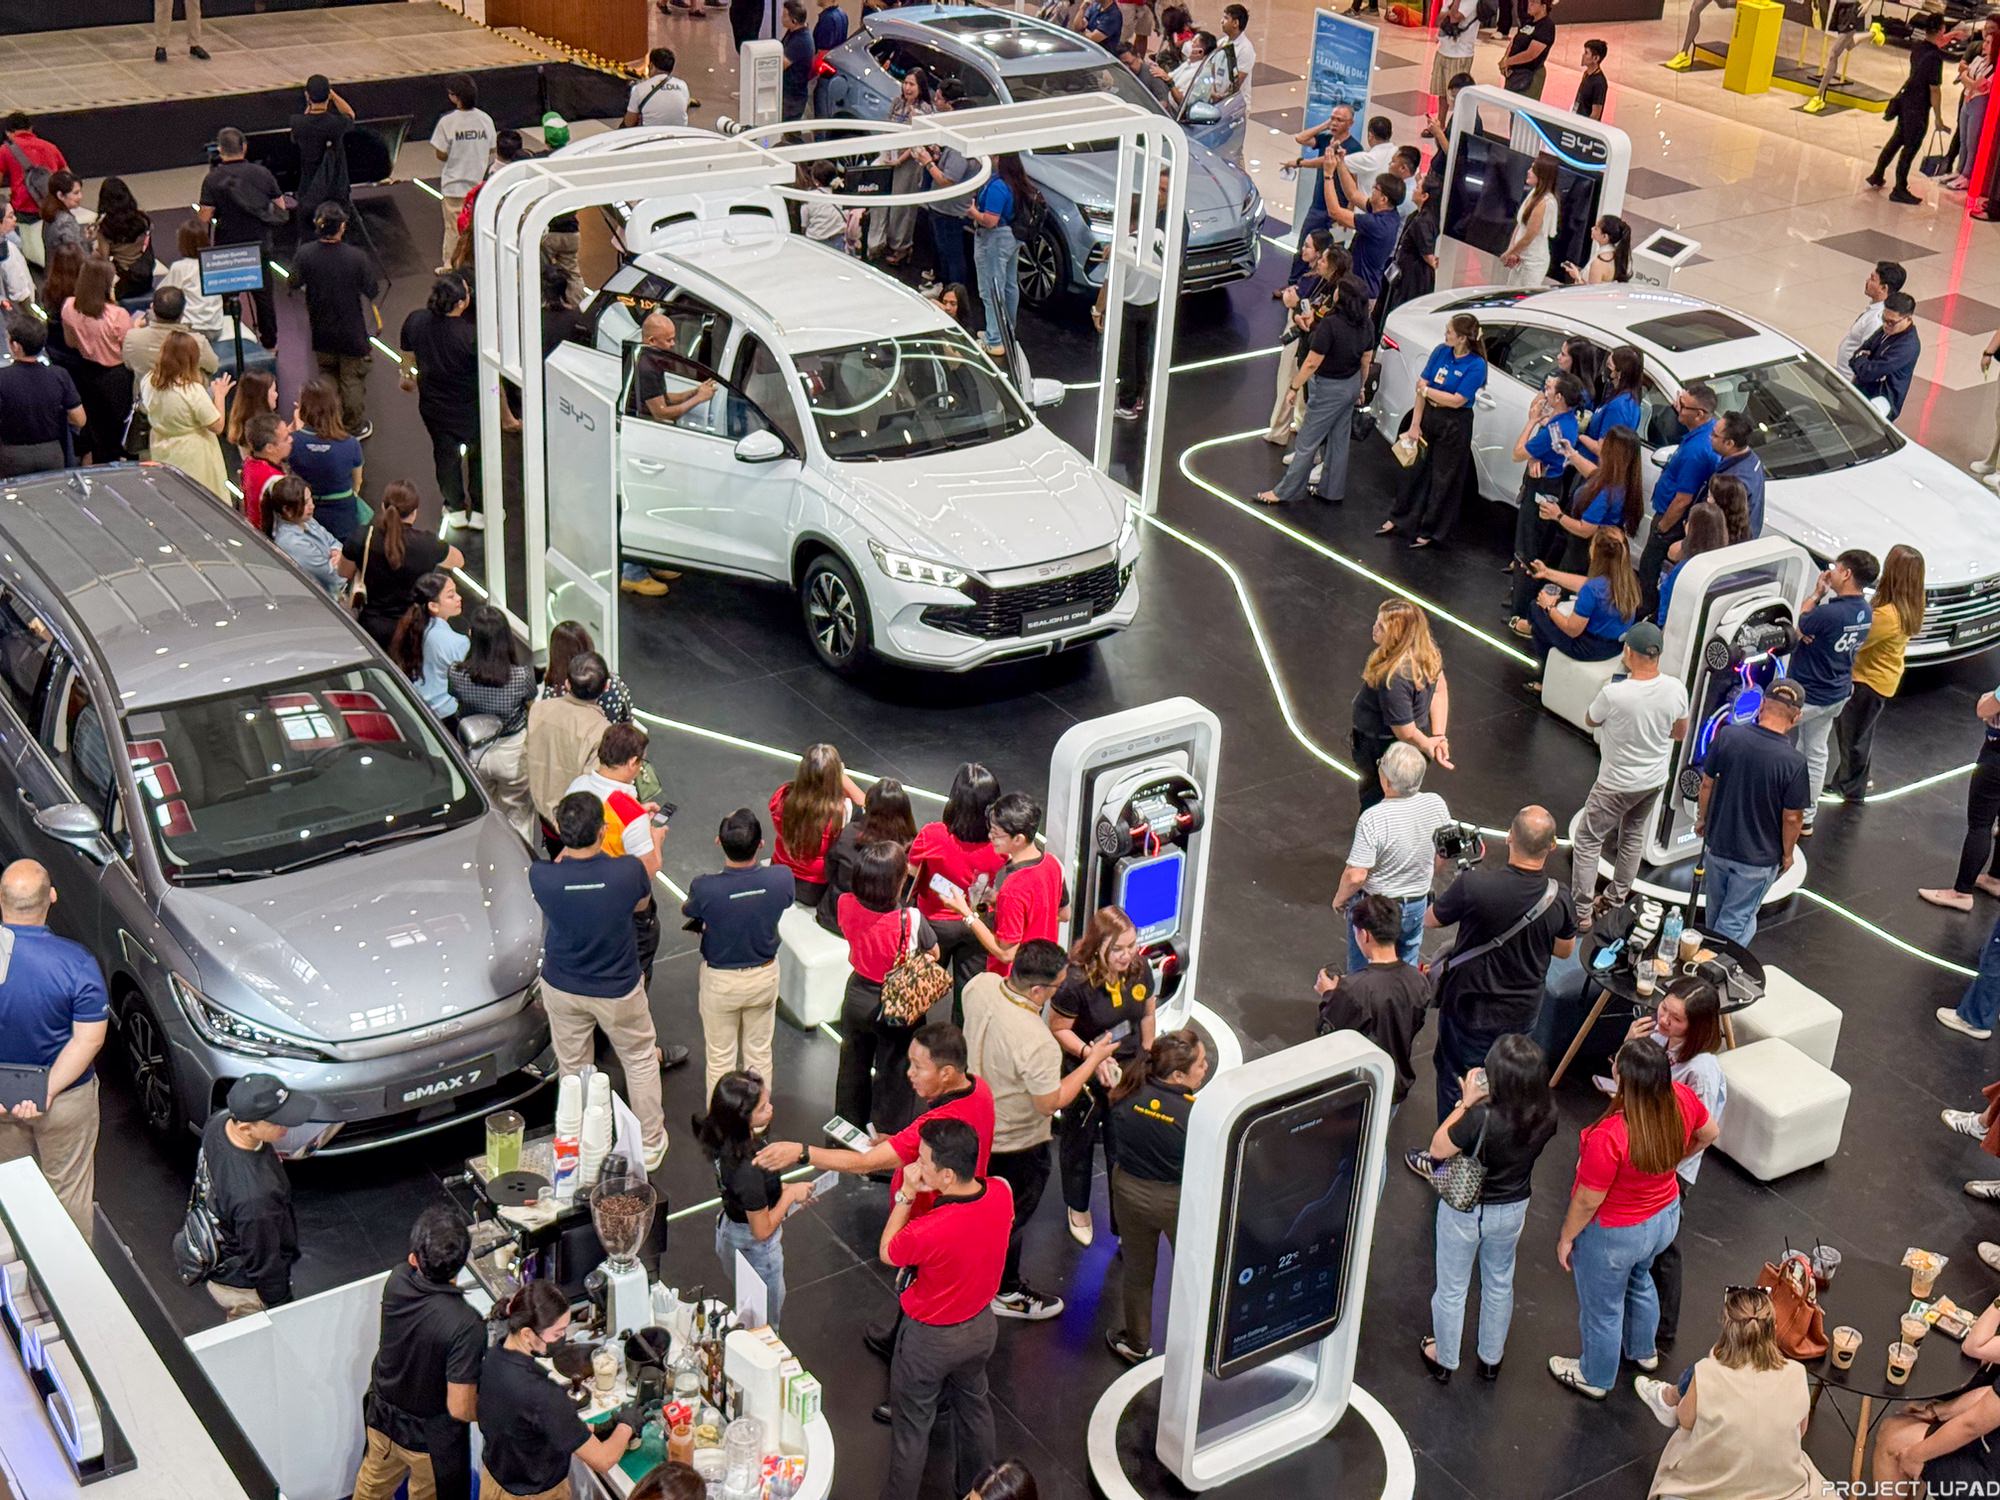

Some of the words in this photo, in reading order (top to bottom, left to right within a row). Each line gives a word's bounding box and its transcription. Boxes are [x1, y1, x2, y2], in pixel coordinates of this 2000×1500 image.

[455, 130, 487, 141] MEDIA
[1560, 131, 1607, 159] BYD
[857, 183, 879, 192] Media
[1635, 271, 1660, 287] BYD
[559, 396, 596, 432] BYD
[1038, 562, 1073, 577] BYD
[1027, 616, 1063, 630] SEALION
[1958, 627, 1982, 639] SEAL
[403, 1075, 464, 1103] eMAX
[468, 1069, 482, 1085] 7
